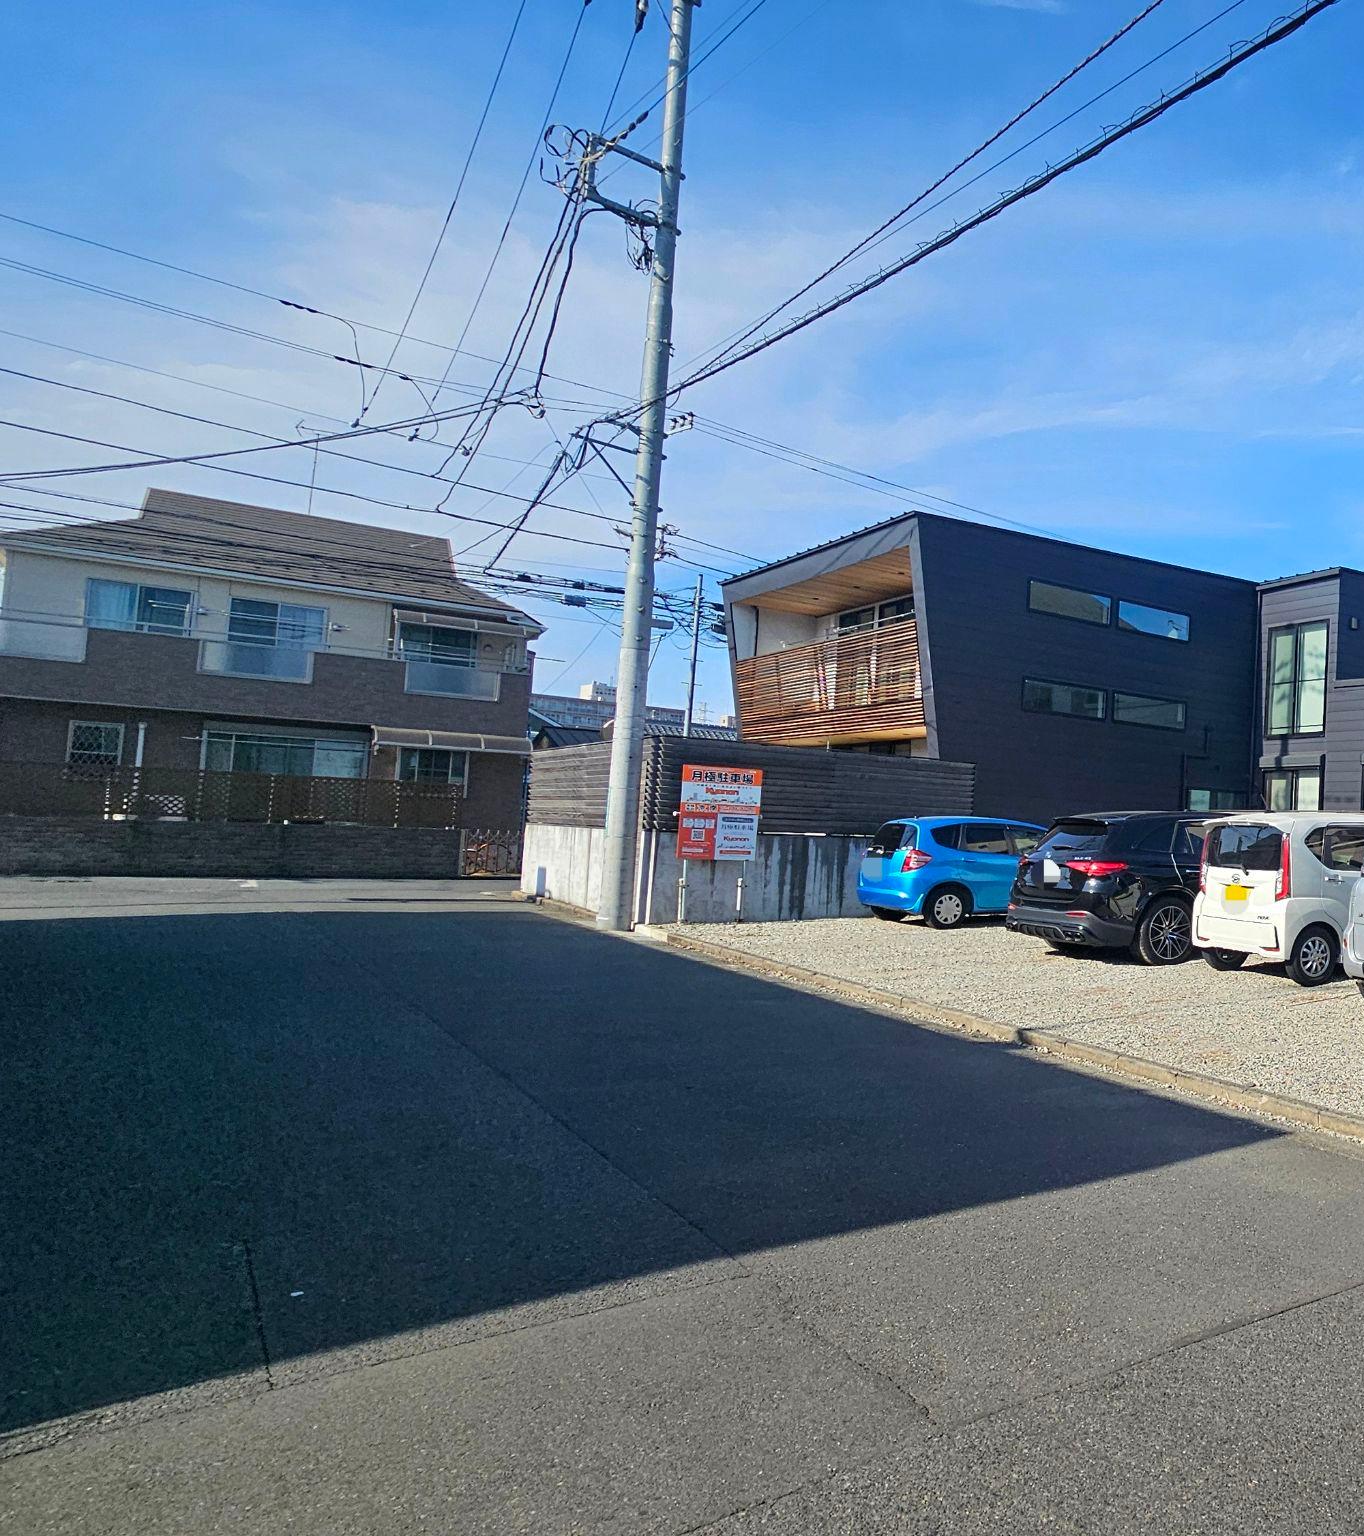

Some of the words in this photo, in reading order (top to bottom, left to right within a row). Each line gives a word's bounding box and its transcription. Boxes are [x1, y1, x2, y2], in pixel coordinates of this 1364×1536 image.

[692, 770, 754, 784] 月極駐車場
